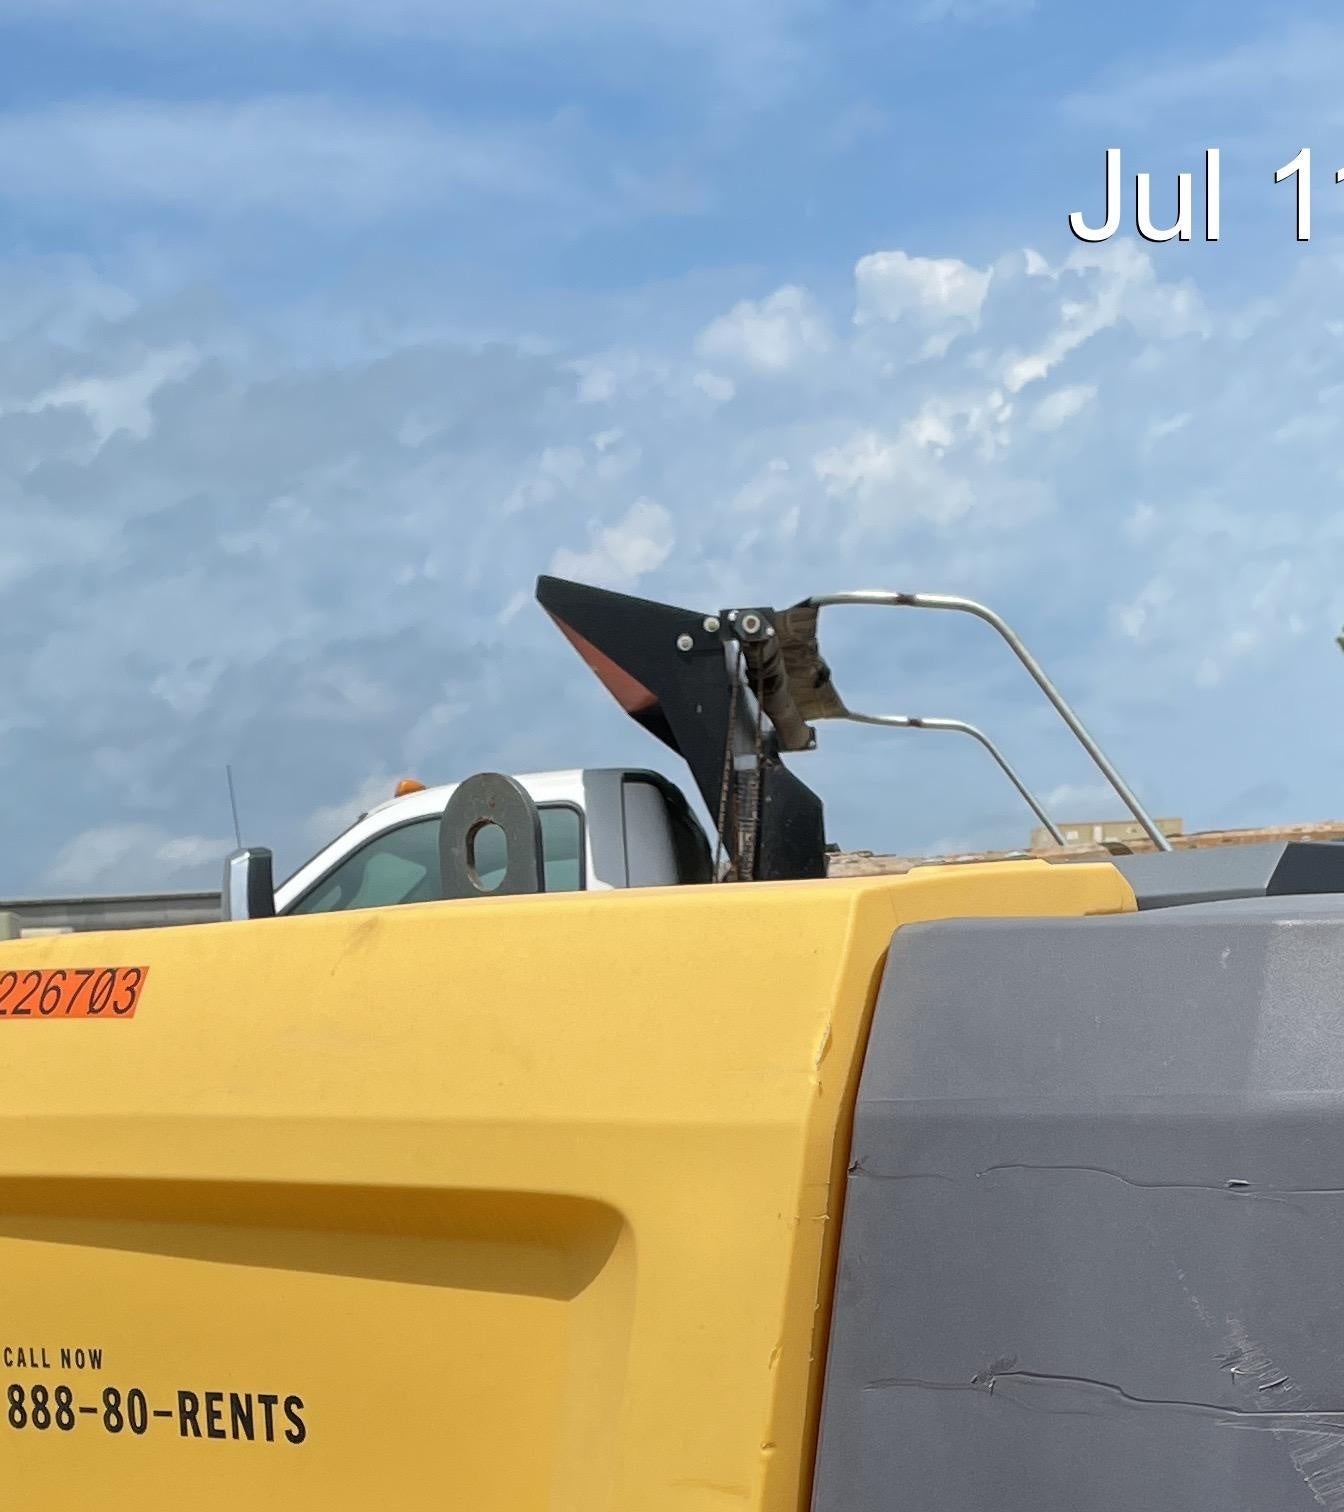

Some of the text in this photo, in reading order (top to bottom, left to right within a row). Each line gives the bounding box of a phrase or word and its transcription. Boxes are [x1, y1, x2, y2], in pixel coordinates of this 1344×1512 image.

[3, 1347, 103, 1369] CALL NOW
[7, 1383, 307, 1445] 888-80-RENTS
